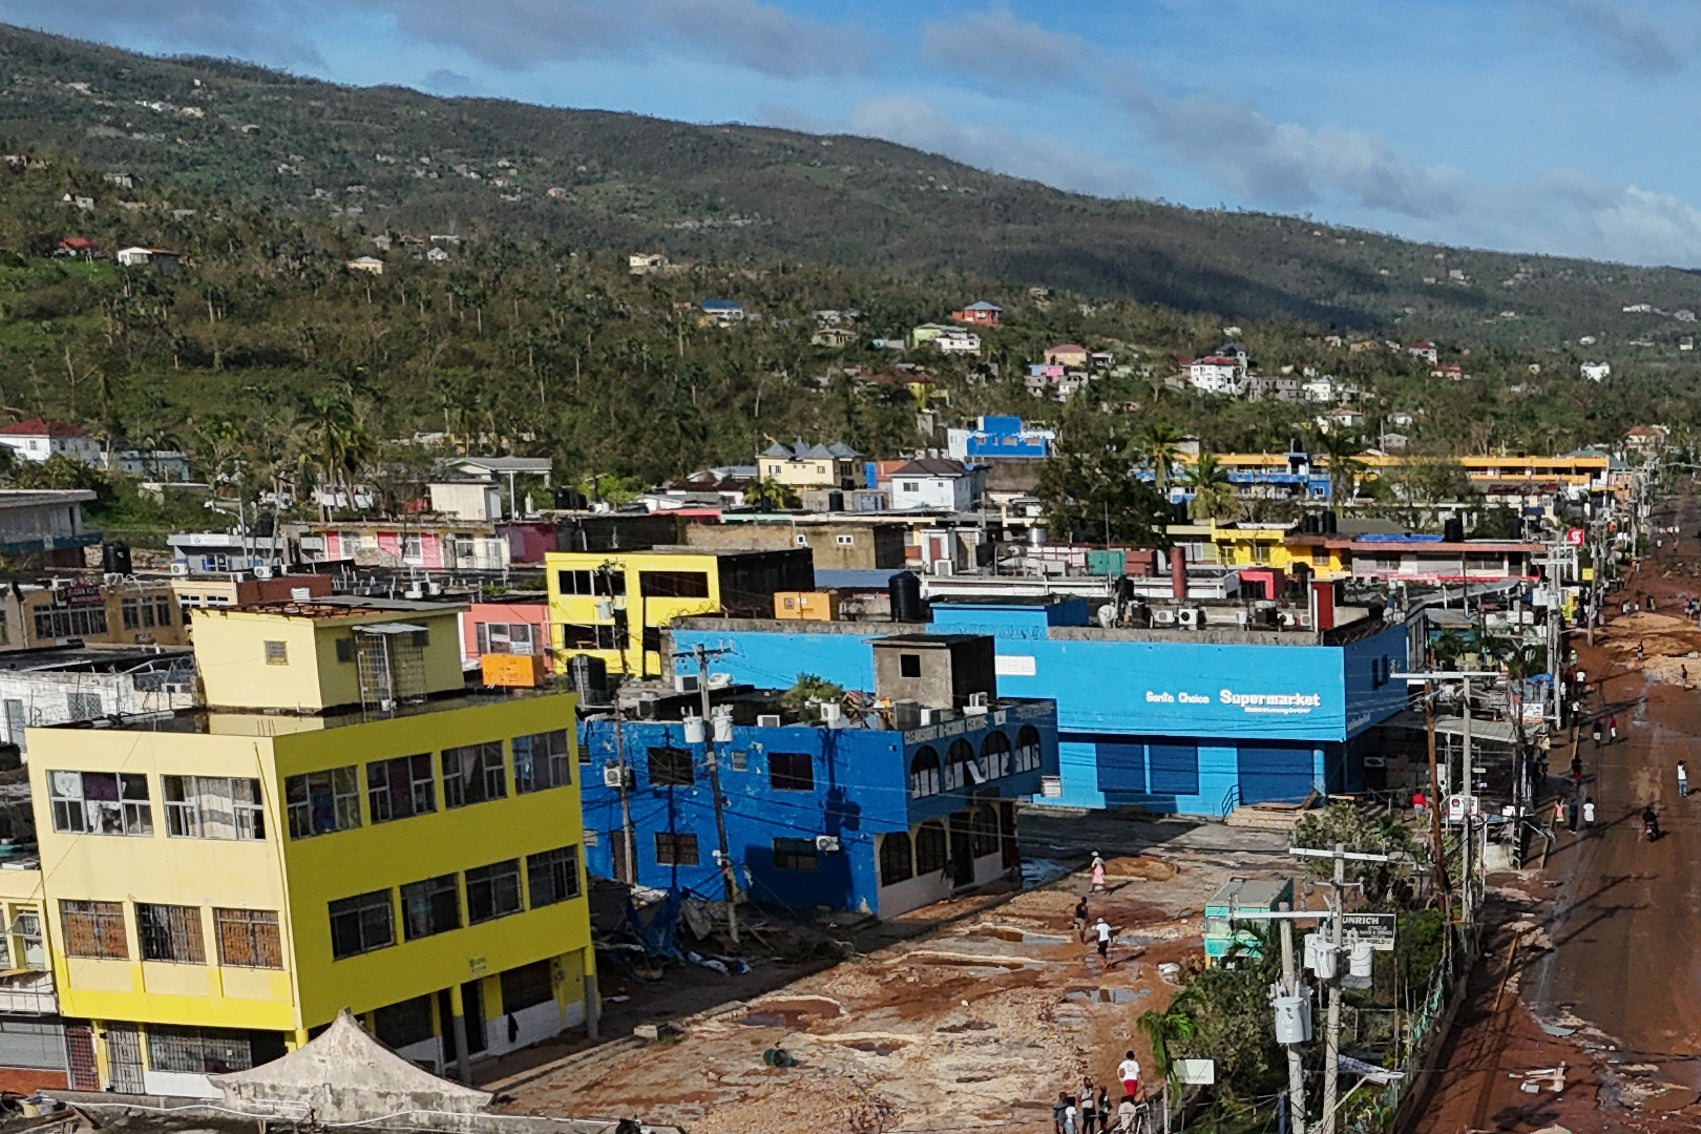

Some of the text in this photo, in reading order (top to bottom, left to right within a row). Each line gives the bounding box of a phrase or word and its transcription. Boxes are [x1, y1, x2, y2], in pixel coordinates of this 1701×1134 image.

[1178, 692, 1210, 704] Choice
[1219, 689, 1321, 707] Supermarket
[1342, 917, 1380, 925] UNRICH
